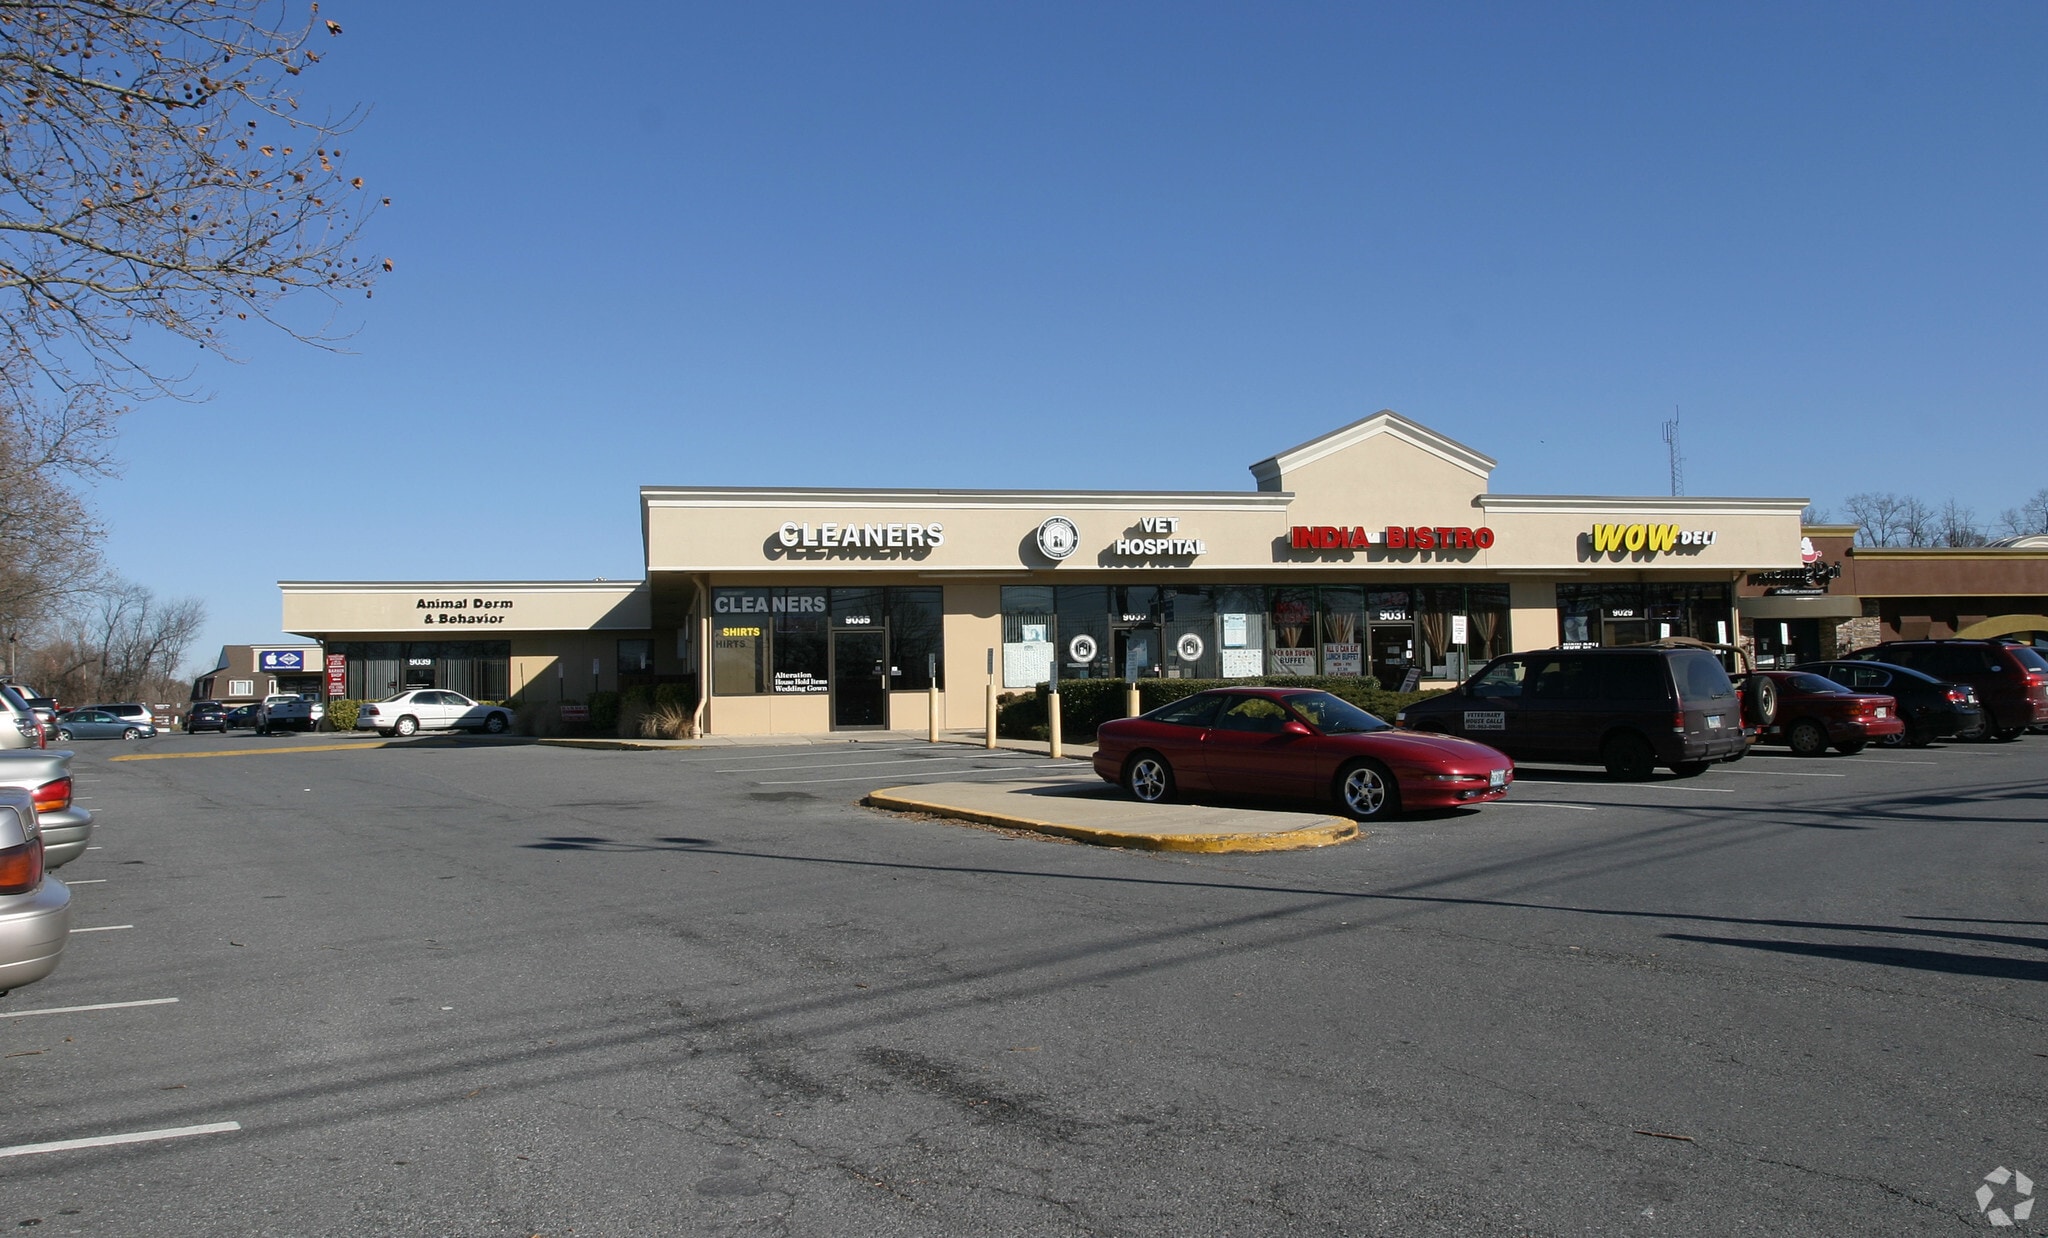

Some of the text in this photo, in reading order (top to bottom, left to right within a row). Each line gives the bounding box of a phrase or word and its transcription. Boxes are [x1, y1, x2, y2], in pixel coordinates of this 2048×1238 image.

[1140, 517, 1179, 533] VET
[779, 521, 945, 548] CLEANERS
[1291, 526, 1495, 550] INDIA BISTRO
[1594, 523, 1717, 552] WOW DELI
[1116, 538, 1207, 555] HOSPITAL
[416, 598, 513, 609] Animal Derm
[715, 596, 826, 613] CLEANERS
[424, 613, 505, 624] & Behavior
[845, 615, 871, 625] 9035
[1379, 610, 1406, 620] 9031
[722, 627, 760, 637] SHIRTS
[1350, 645, 1358, 653] EAT
[409, 658, 432, 666] 9039
[775, 671, 812, 679] Alteration
[775, 685, 806, 693] Wedding
